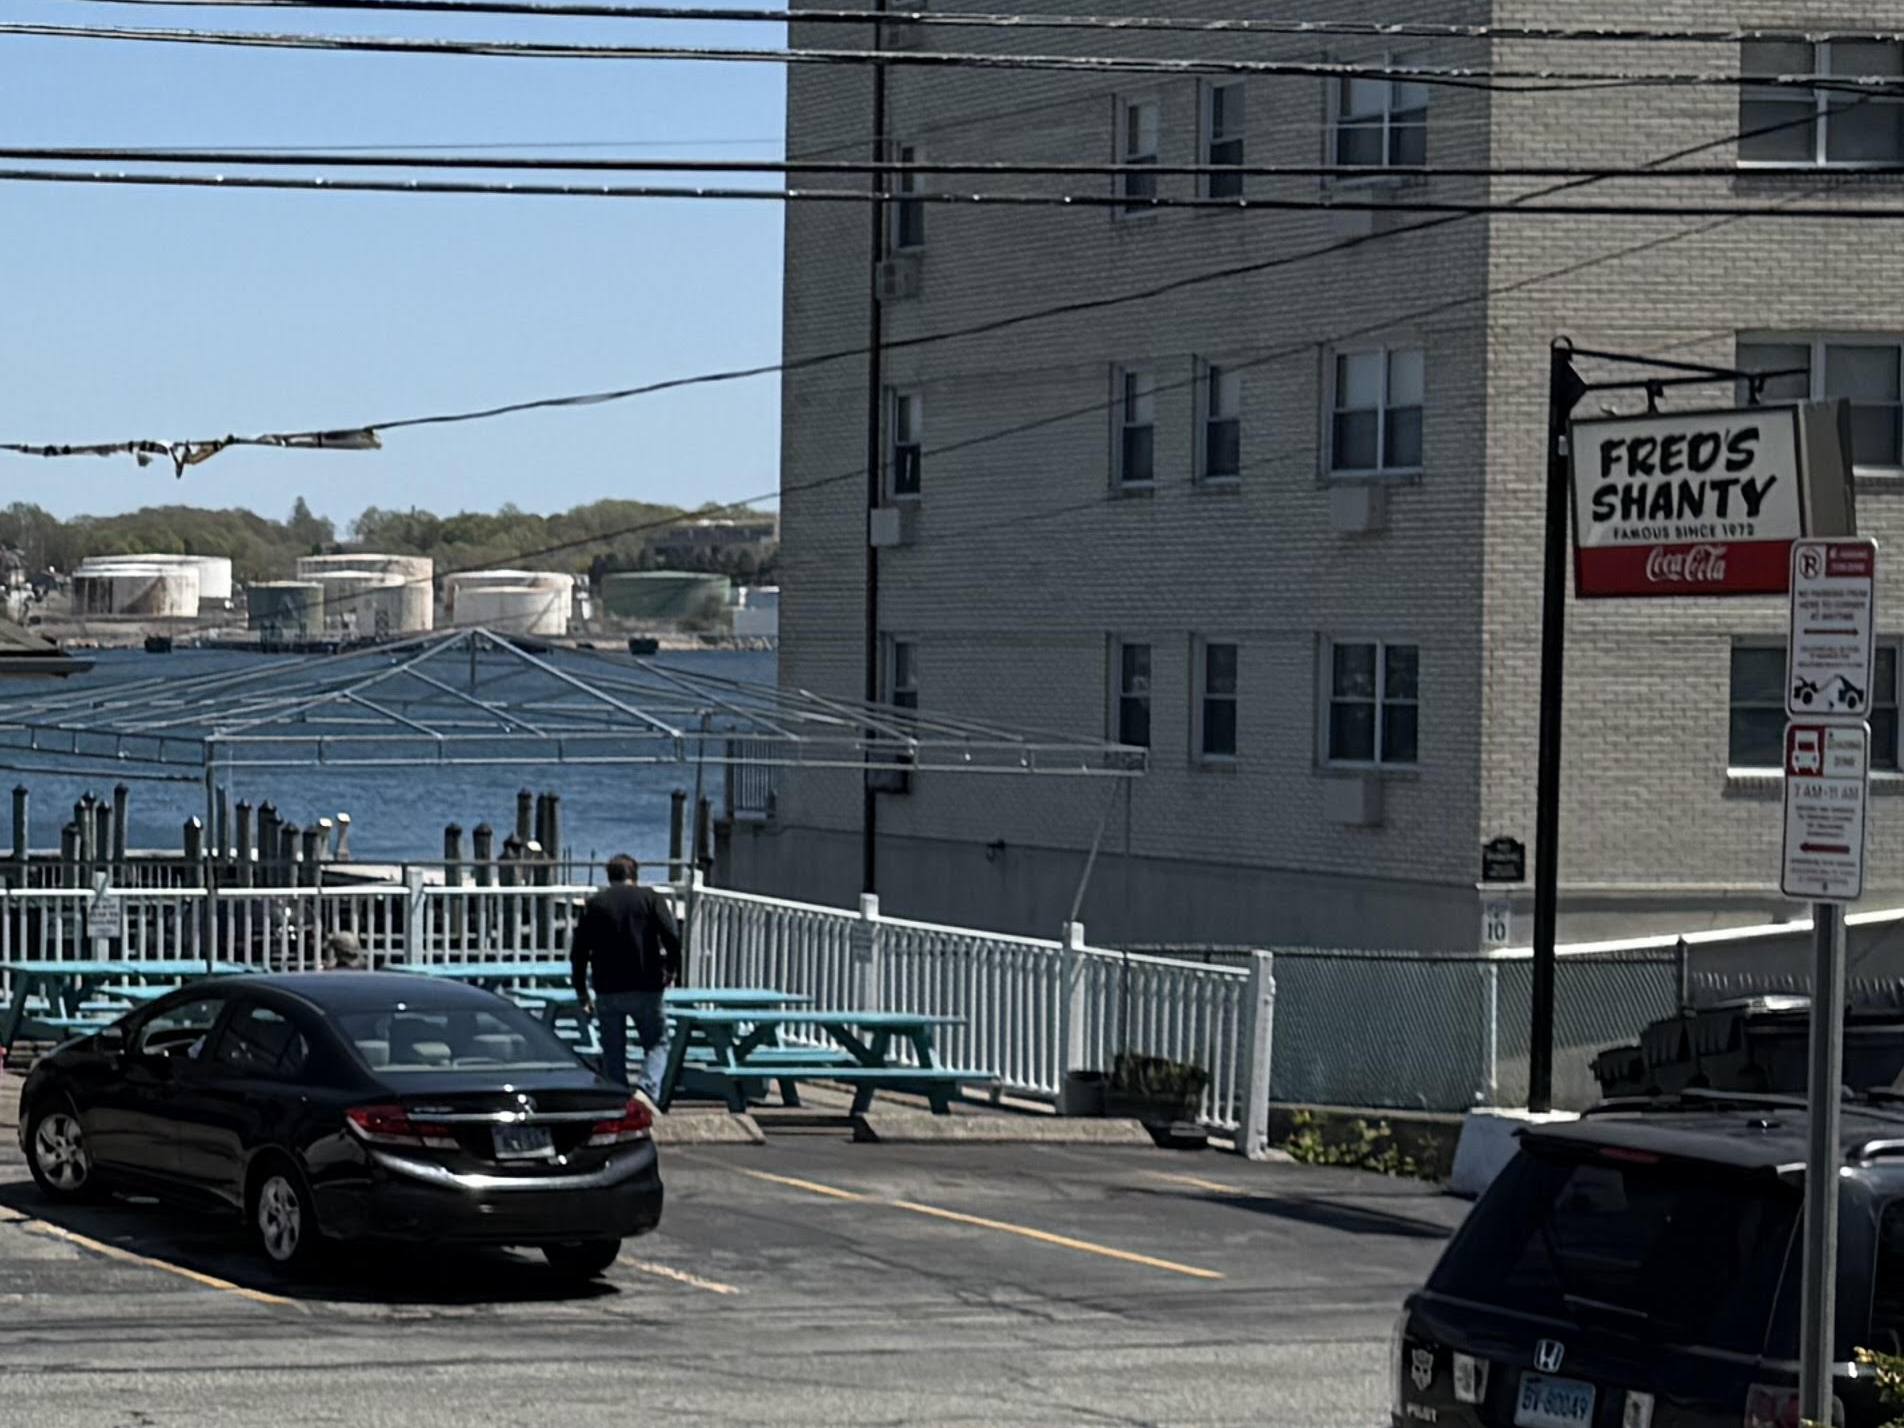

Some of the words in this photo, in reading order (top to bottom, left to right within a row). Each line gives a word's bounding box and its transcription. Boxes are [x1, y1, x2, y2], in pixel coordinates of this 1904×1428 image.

[1600, 427, 1760, 478] FRED'S
[1592, 474, 1777, 522] SHANTY
[1613, 525, 1670, 540] FAMOUS
[1675, 523, 1716, 538] SINCE
[1487, 922, 1506, 941] 10
